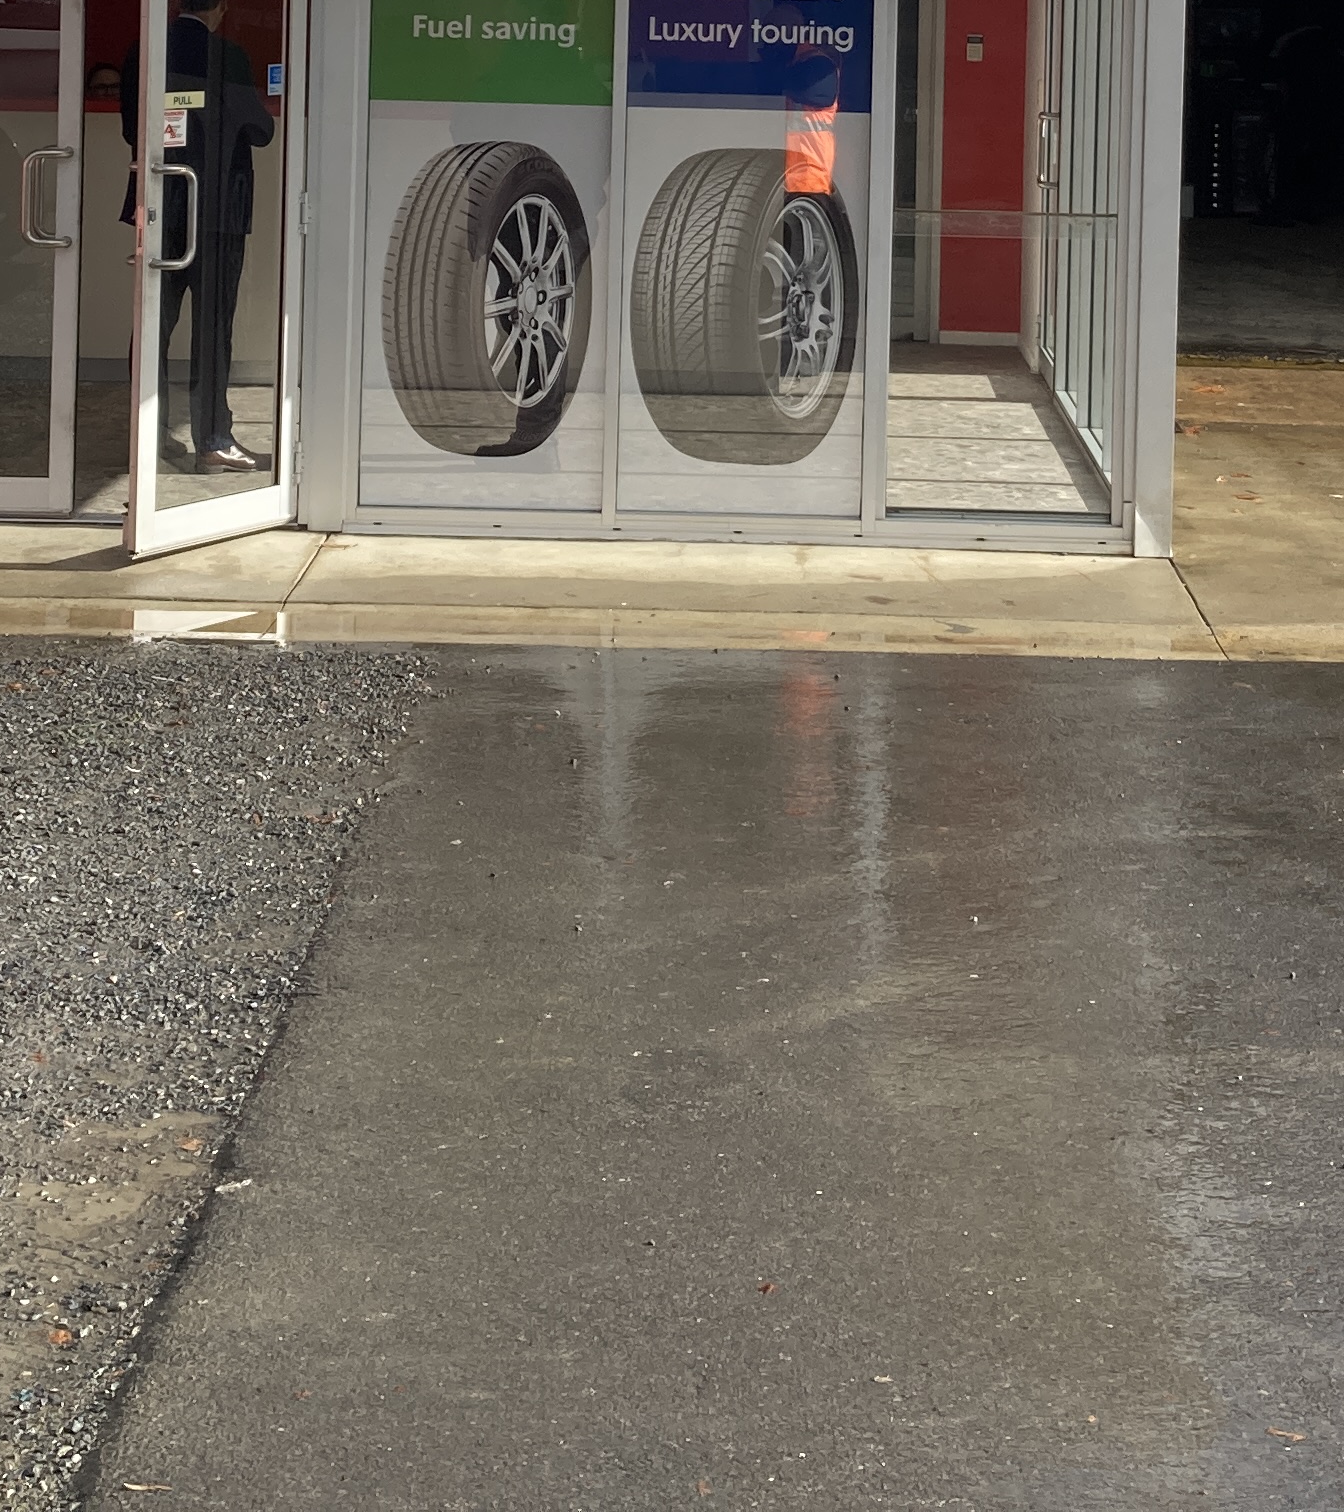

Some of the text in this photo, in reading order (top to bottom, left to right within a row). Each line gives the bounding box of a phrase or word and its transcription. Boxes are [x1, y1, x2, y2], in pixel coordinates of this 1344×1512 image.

[413, 14, 576, 47] Fuel saving
[648, 17, 855, 52] Luxury touring
[173, 96, 192, 105] PULL
